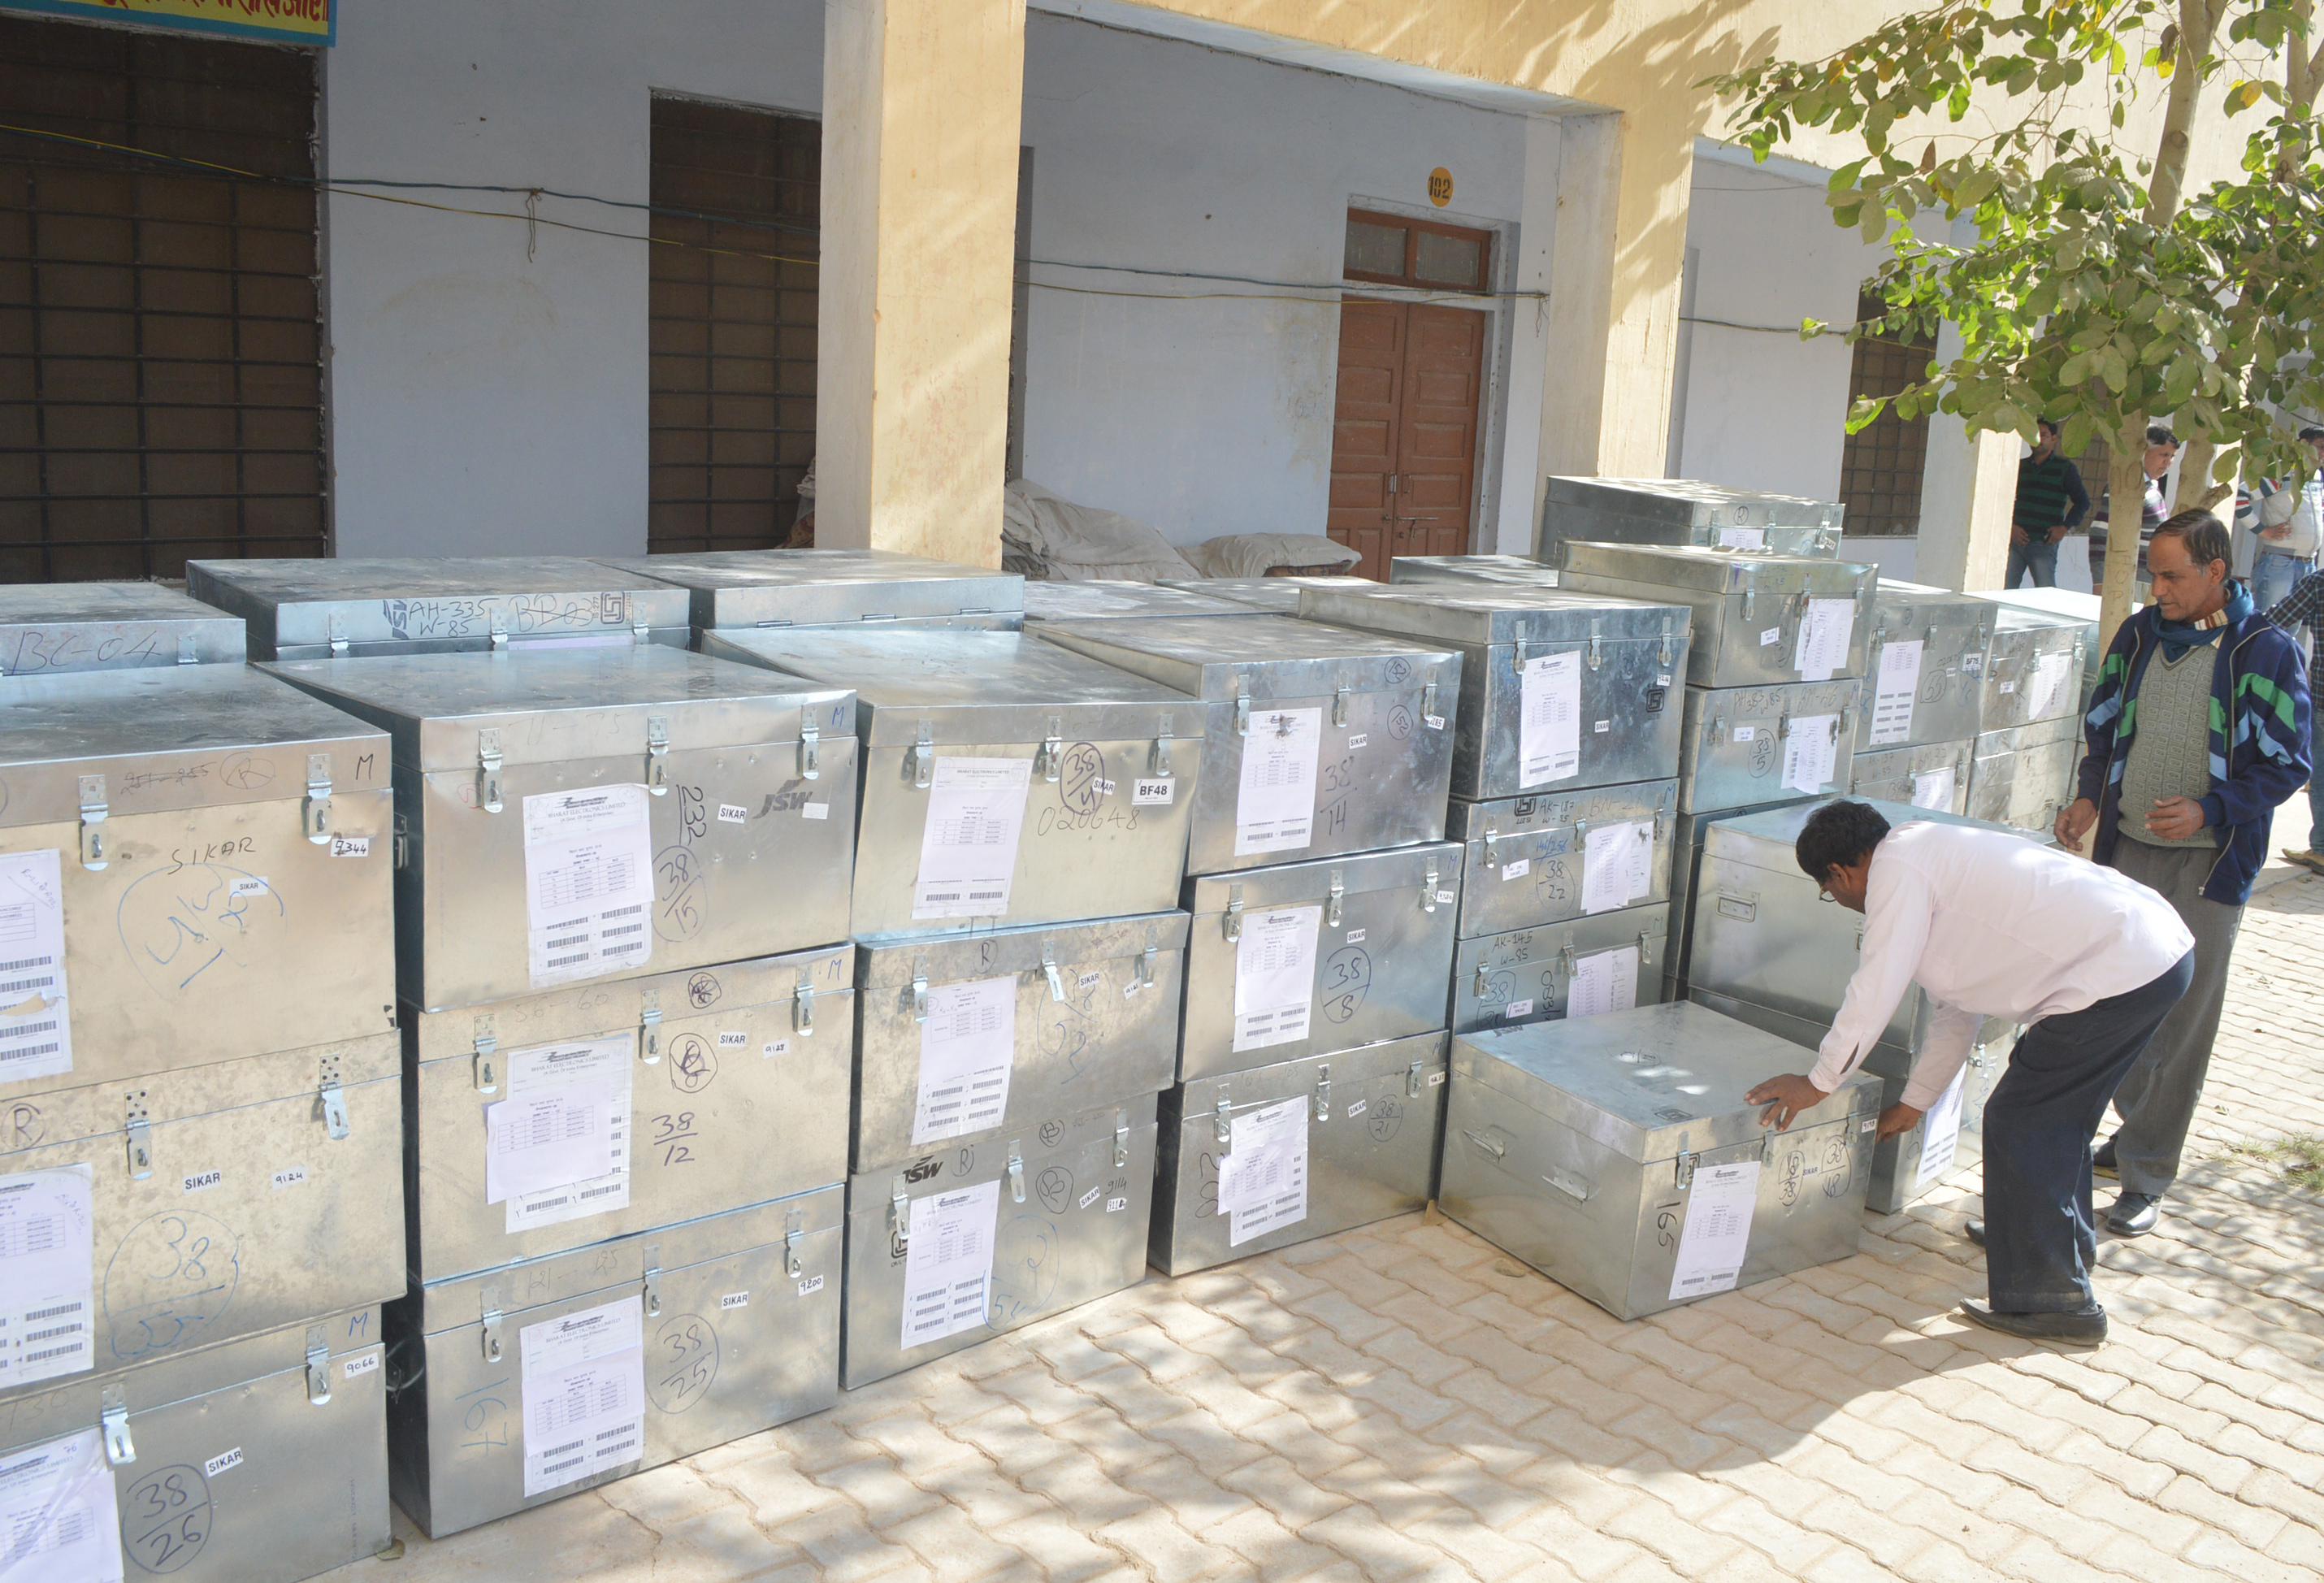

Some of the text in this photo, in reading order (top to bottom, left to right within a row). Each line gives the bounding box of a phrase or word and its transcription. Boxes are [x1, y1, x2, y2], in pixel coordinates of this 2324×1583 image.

[1429, 176, 1450, 199] 102
[12, 631, 162, 674] BC-04
[830, 705, 845, 726] M
[1350, 736, 1367, 746] SIKAR
[1753, 737, 1770, 754] 38
[356, 753, 374, 780] M
[1066, 748, 1095, 785] 38
[1756, 756, 1766, 771] 5
[1094, 780, 1114, 792] SIKAR
[1140, 786, 1168, 796] BF48
[570, 805, 605, 815] ELECTRONICS
[605, 802, 626, 810] LIMITED
[720, 808, 746, 820] SIKAR
[752, 791, 813, 820] JSW
[1038, 805, 1141, 836] 020648
[1327, 800, 1346, 836] 14
[168, 838, 255, 874] SIKAR
[659, 853, 689, 902] 38
[1546, 860, 1564, 878] 38
[240, 882, 258, 891] SIKAR
[1548, 884, 1566, 900] 22
[1348, 930, 1365, 940] SIKAR
[828, 958, 842, 980] M
[1329, 957, 1362, 990] 38
[1080, 974, 1099, 986] SIKAR
[1342, 994, 1354, 1018] 8
[720, 1034, 746, 1044] SIKAR
[553, 1059, 588, 1069] ELECTRONICS
[1349, 1101, 1366, 1116] SIKAR
[1376, 1100, 1394, 1117] 38
[14, 1108, 33, 1147] R
[653, 1112, 695, 1138] 38
[1375, 1121, 1390, 1135] 21
[663, 1144, 695, 1166] 12
[184, 1172, 221, 1190] SIKAR
[275, 1172, 304, 1184] 9124
[1802, 1167, 1818, 1176] SIKAR
[1081, 1188, 1099, 1207] SIKAR
[1657, 1201, 1681, 1256] 165
[148, 1217, 210, 1281] 38
[723, 1294, 748, 1307] SIKAR
[349, 1312, 368, 1338] M
[663, 1324, 703, 1364] 38
[346, 1357, 376, 1373] 9066
[671, 1360, 707, 1399] 25
[207, 1450, 243, 1473] SIKAR
[135, 1473, 188, 1519] 38
[150, 1514, 202, 1567] 26
